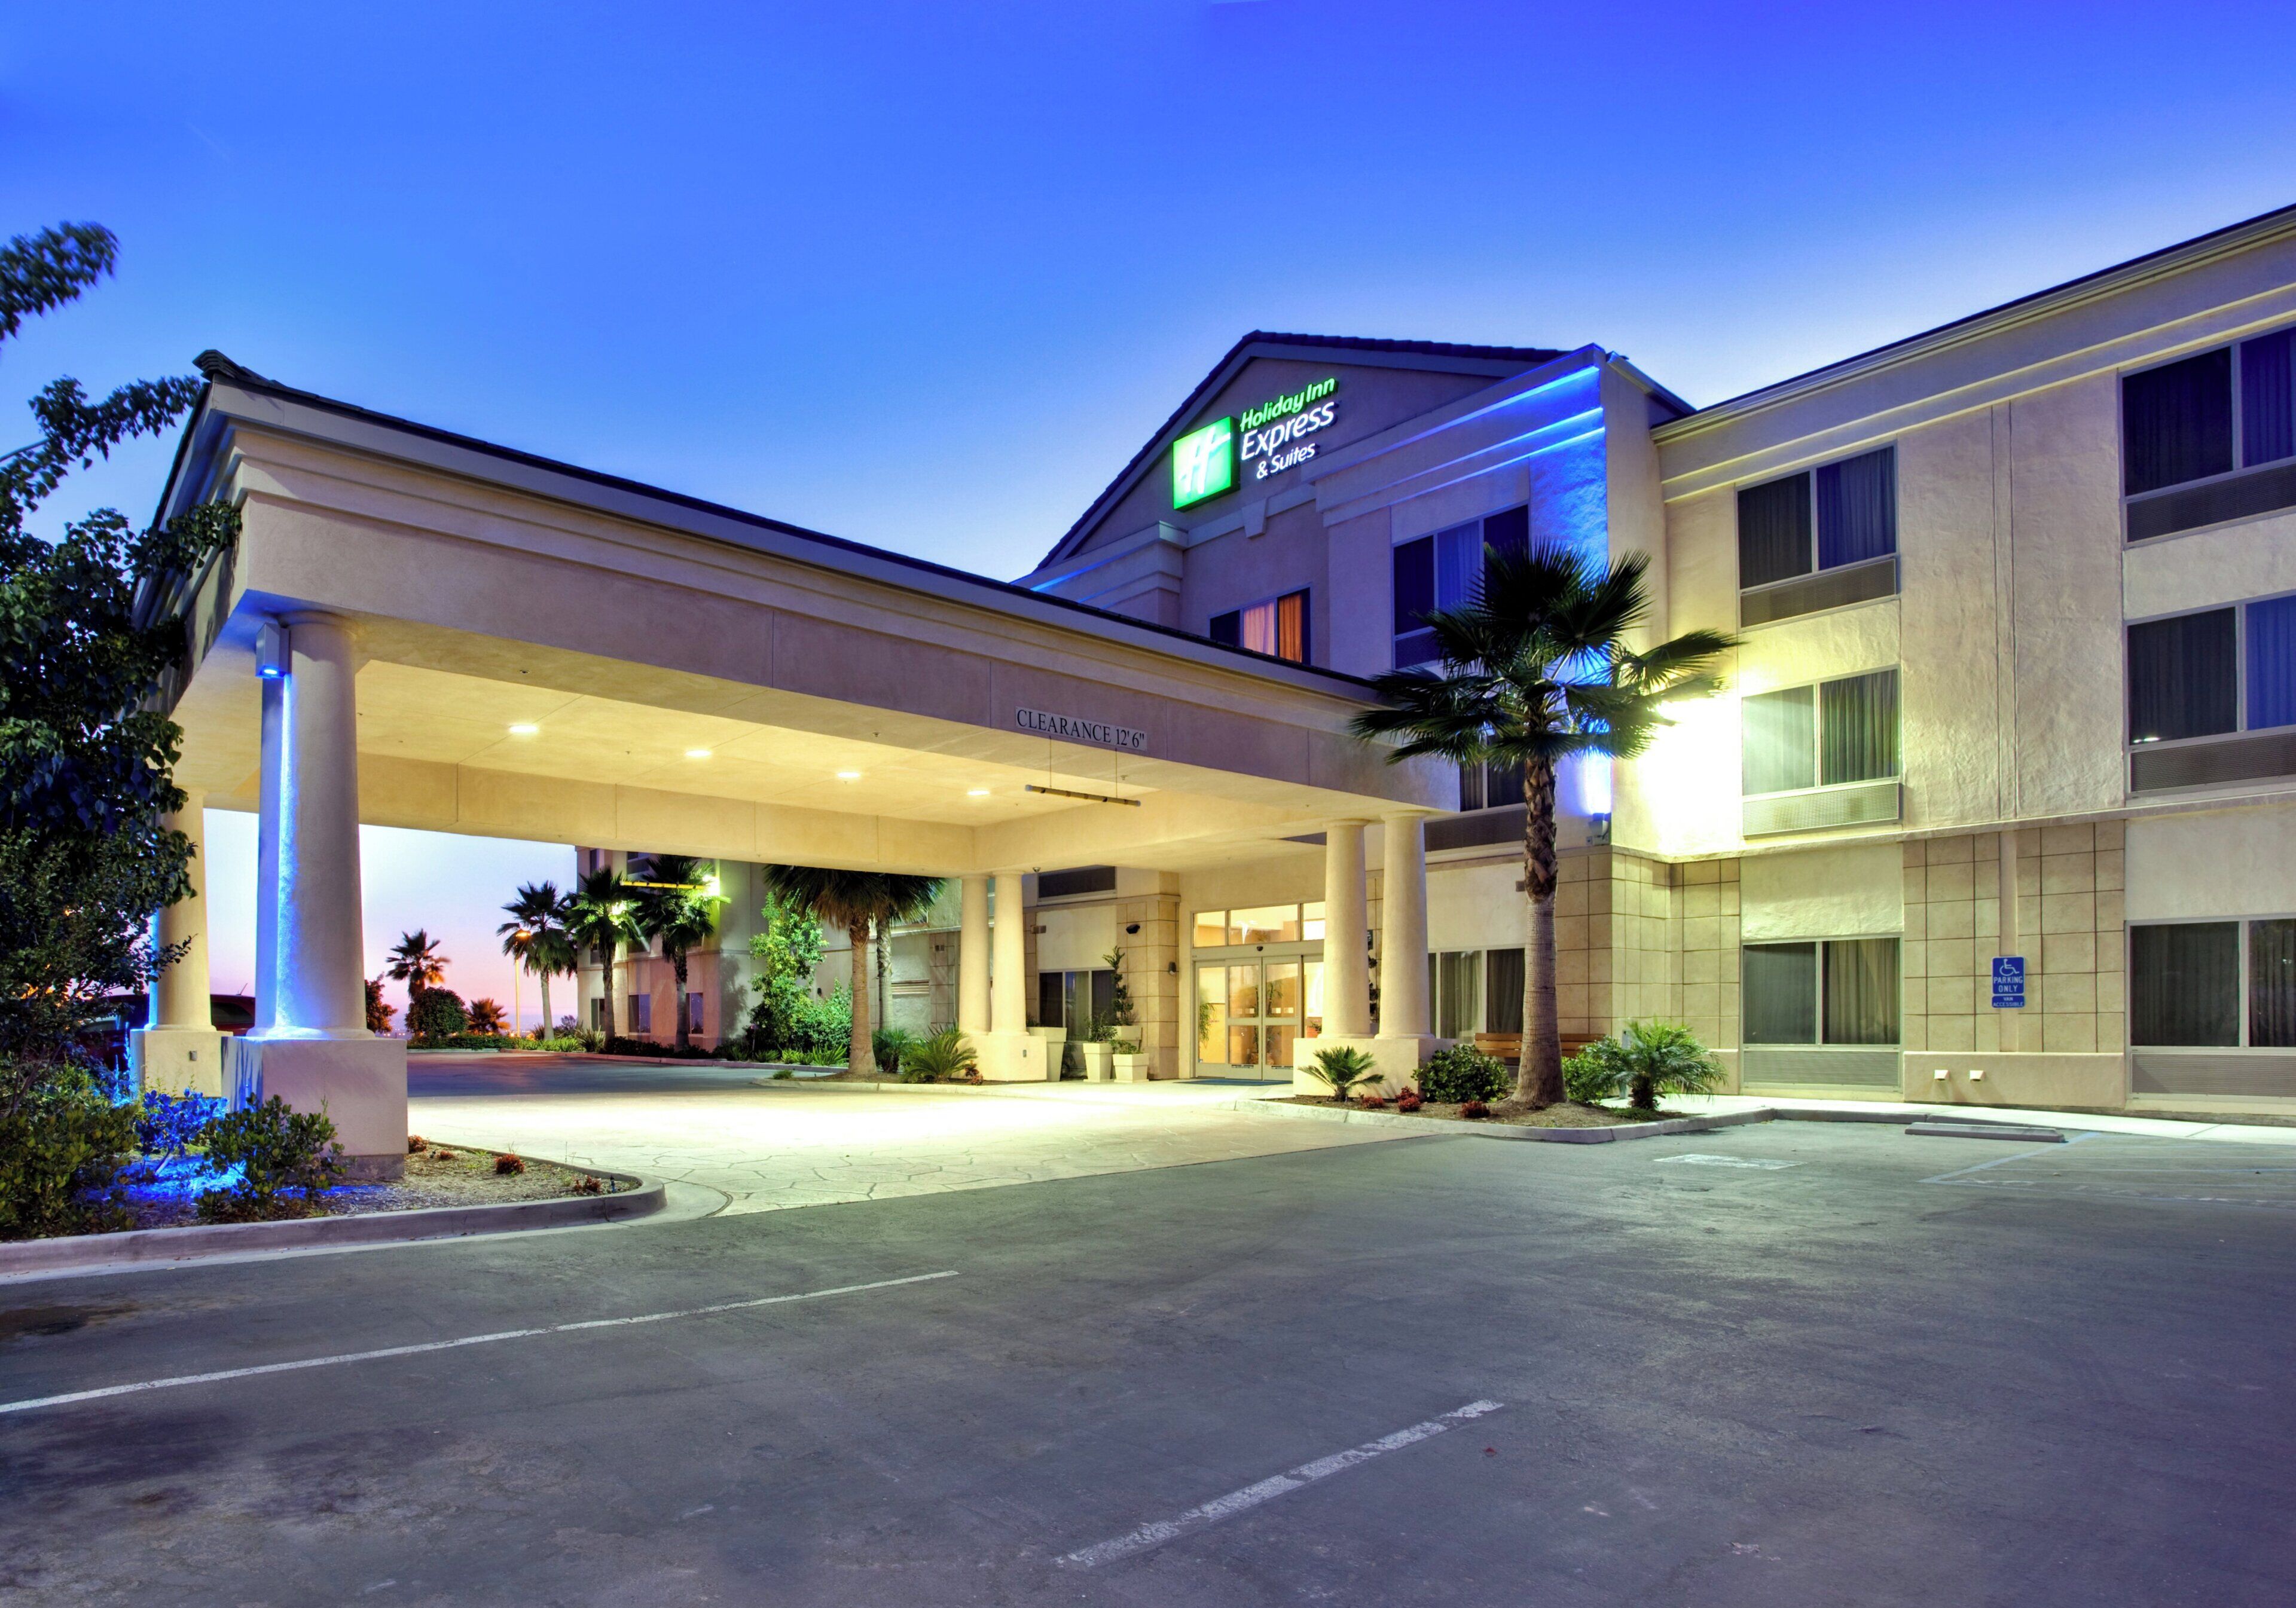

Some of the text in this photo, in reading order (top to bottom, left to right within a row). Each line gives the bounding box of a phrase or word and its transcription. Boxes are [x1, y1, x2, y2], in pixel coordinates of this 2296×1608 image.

[1240, 378, 1336, 432] Holiday Inn
[1241, 402, 1335, 460] Express
[1256, 443, 1315, 479] & Suites
[1017, 710, 1110, 743] CLEARANCE
